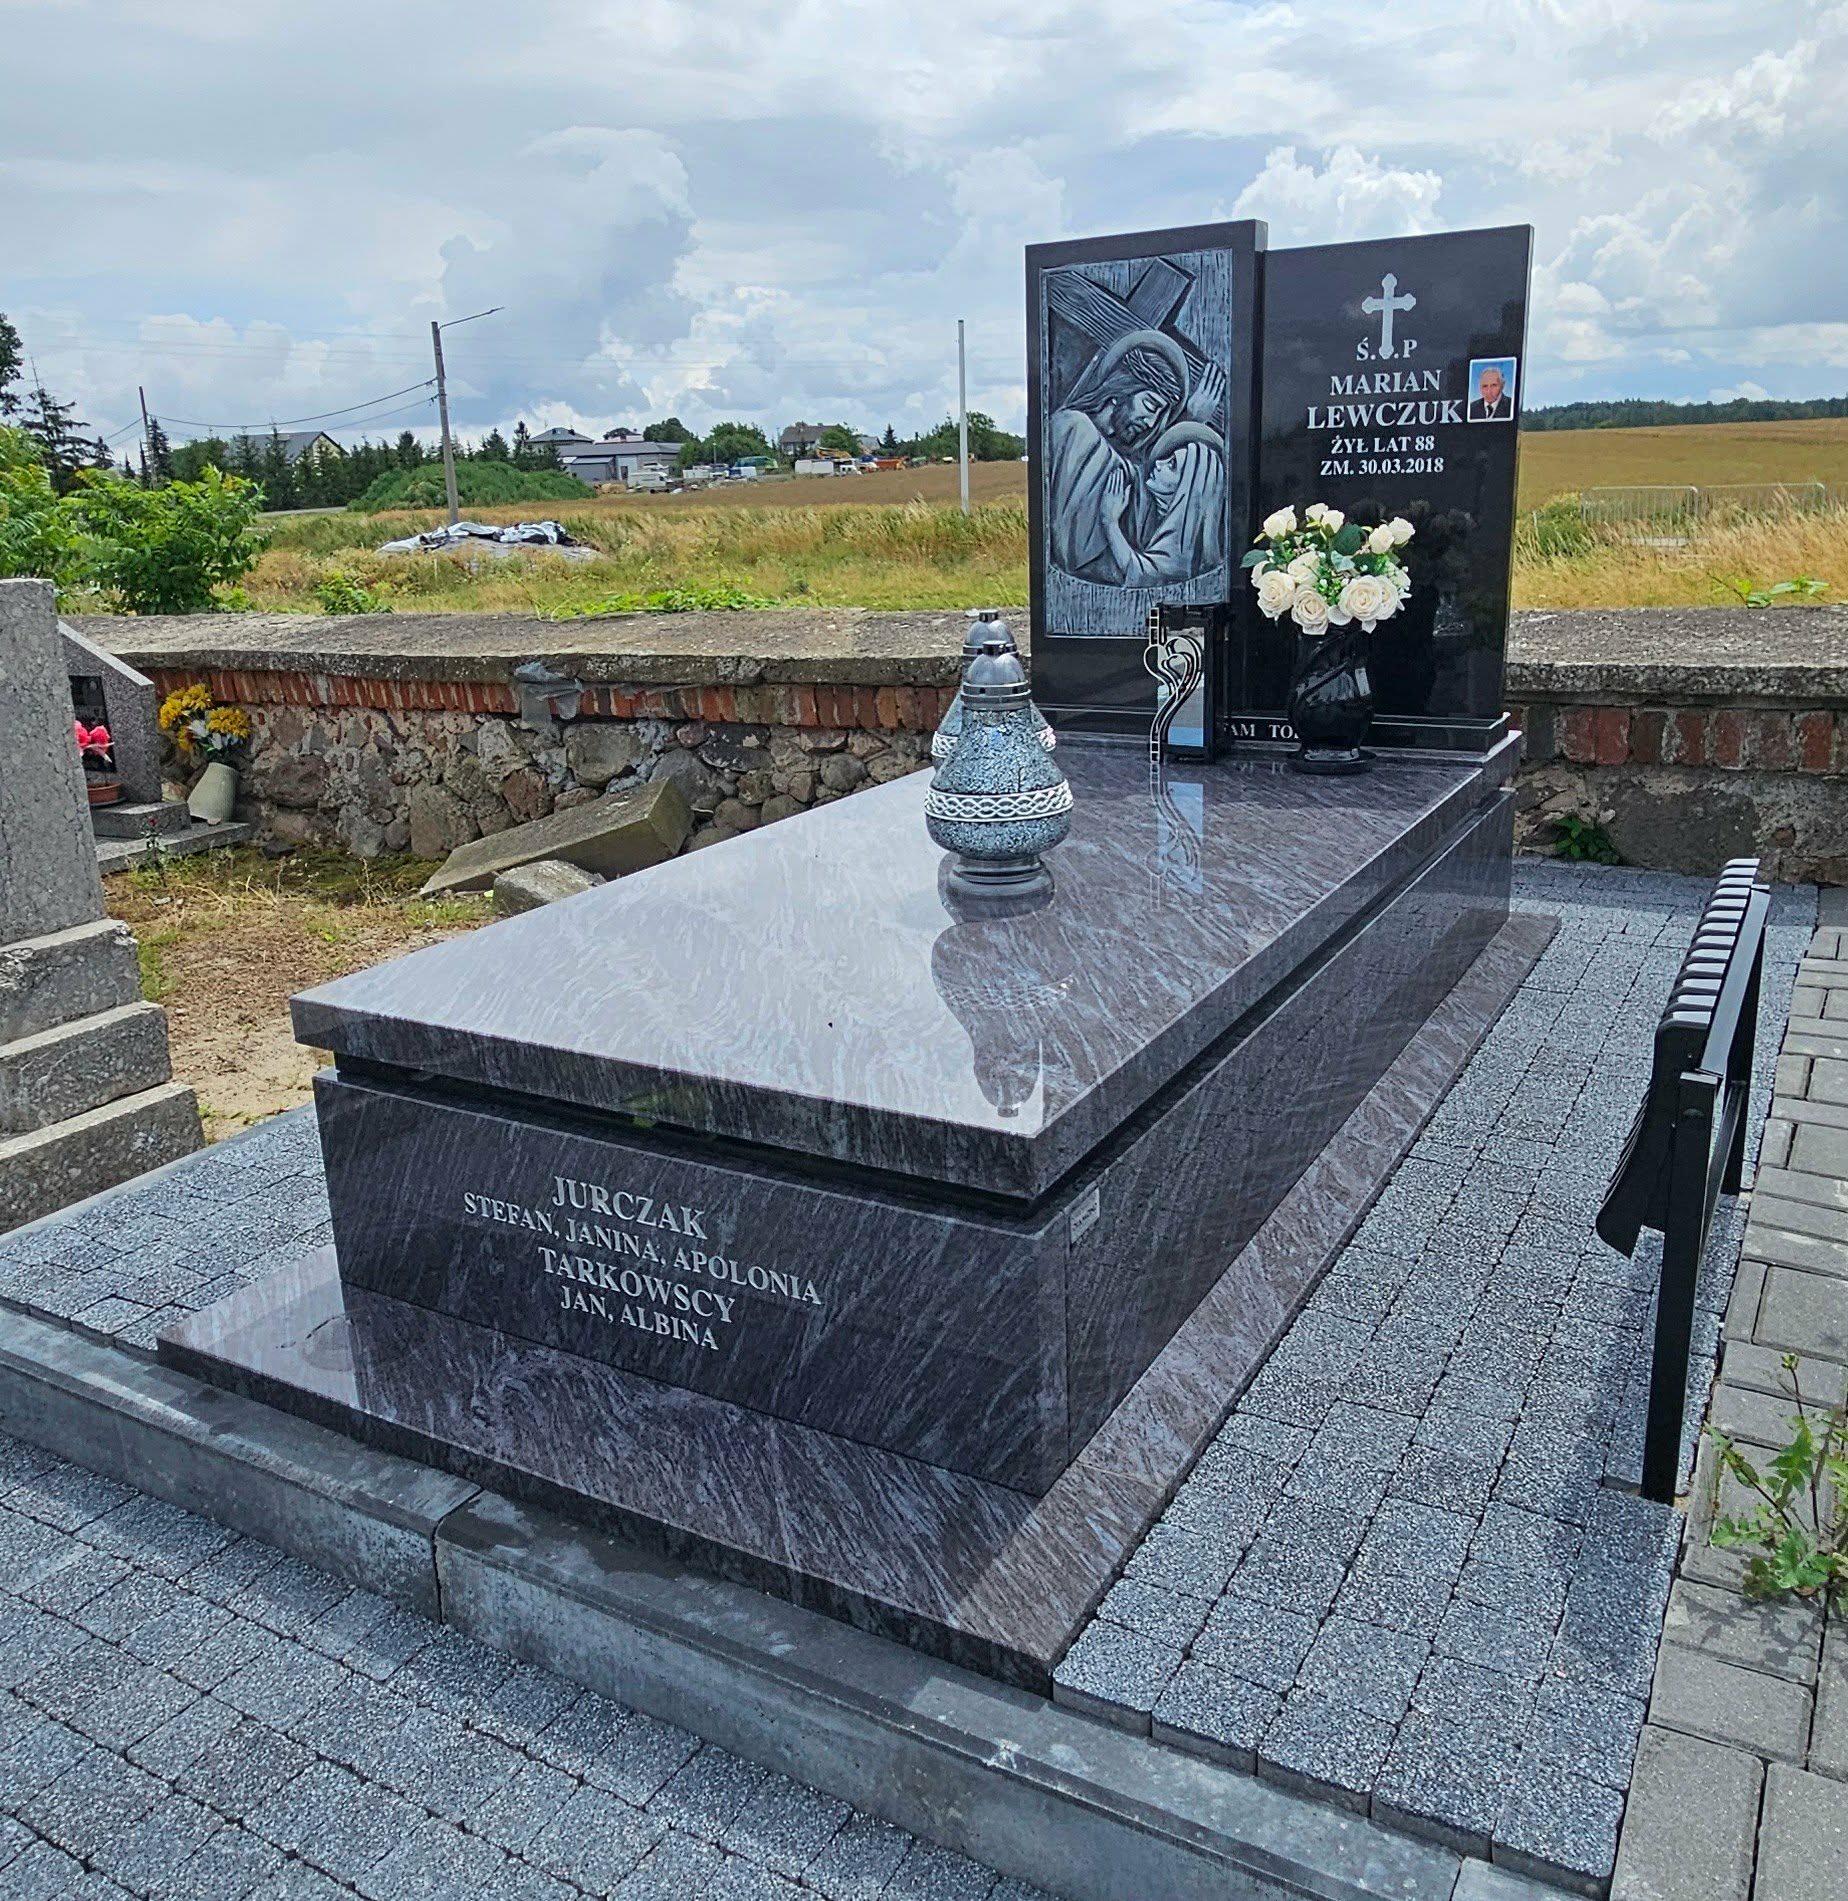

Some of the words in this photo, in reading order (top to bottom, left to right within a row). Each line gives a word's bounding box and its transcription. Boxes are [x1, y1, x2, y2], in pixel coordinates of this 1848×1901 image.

[1329, 369, 1442, 396] MARIAN
[1307, 399, 1463, 430] LEWCZUK
[1331, 435, 1369, 454] ŻYŁ
[1374, 436, 1412, 453] LAT
[1415, 435, 1435, 451] 88
[1320, 460, 1354, 476] ZM.
[1358, 457, 1445, 475] 30.03.2018
[1223, 723, 1255, 737] AM
[1269, 724, 1299, 739] TO
[551, 1175, 709, 1240] JURCZAK
[463, 1191, 561, 1240] STEFAN,
[564, 1217, 667, 1266] JANINA,
[675, 1247, 822, 1306] APOLONIA
[538, 1246, 736, 1324] TARKOWSCY
[560, 1285, 615, 1324] JAN,
[620, 1302, 720, 1351] ALBINA
